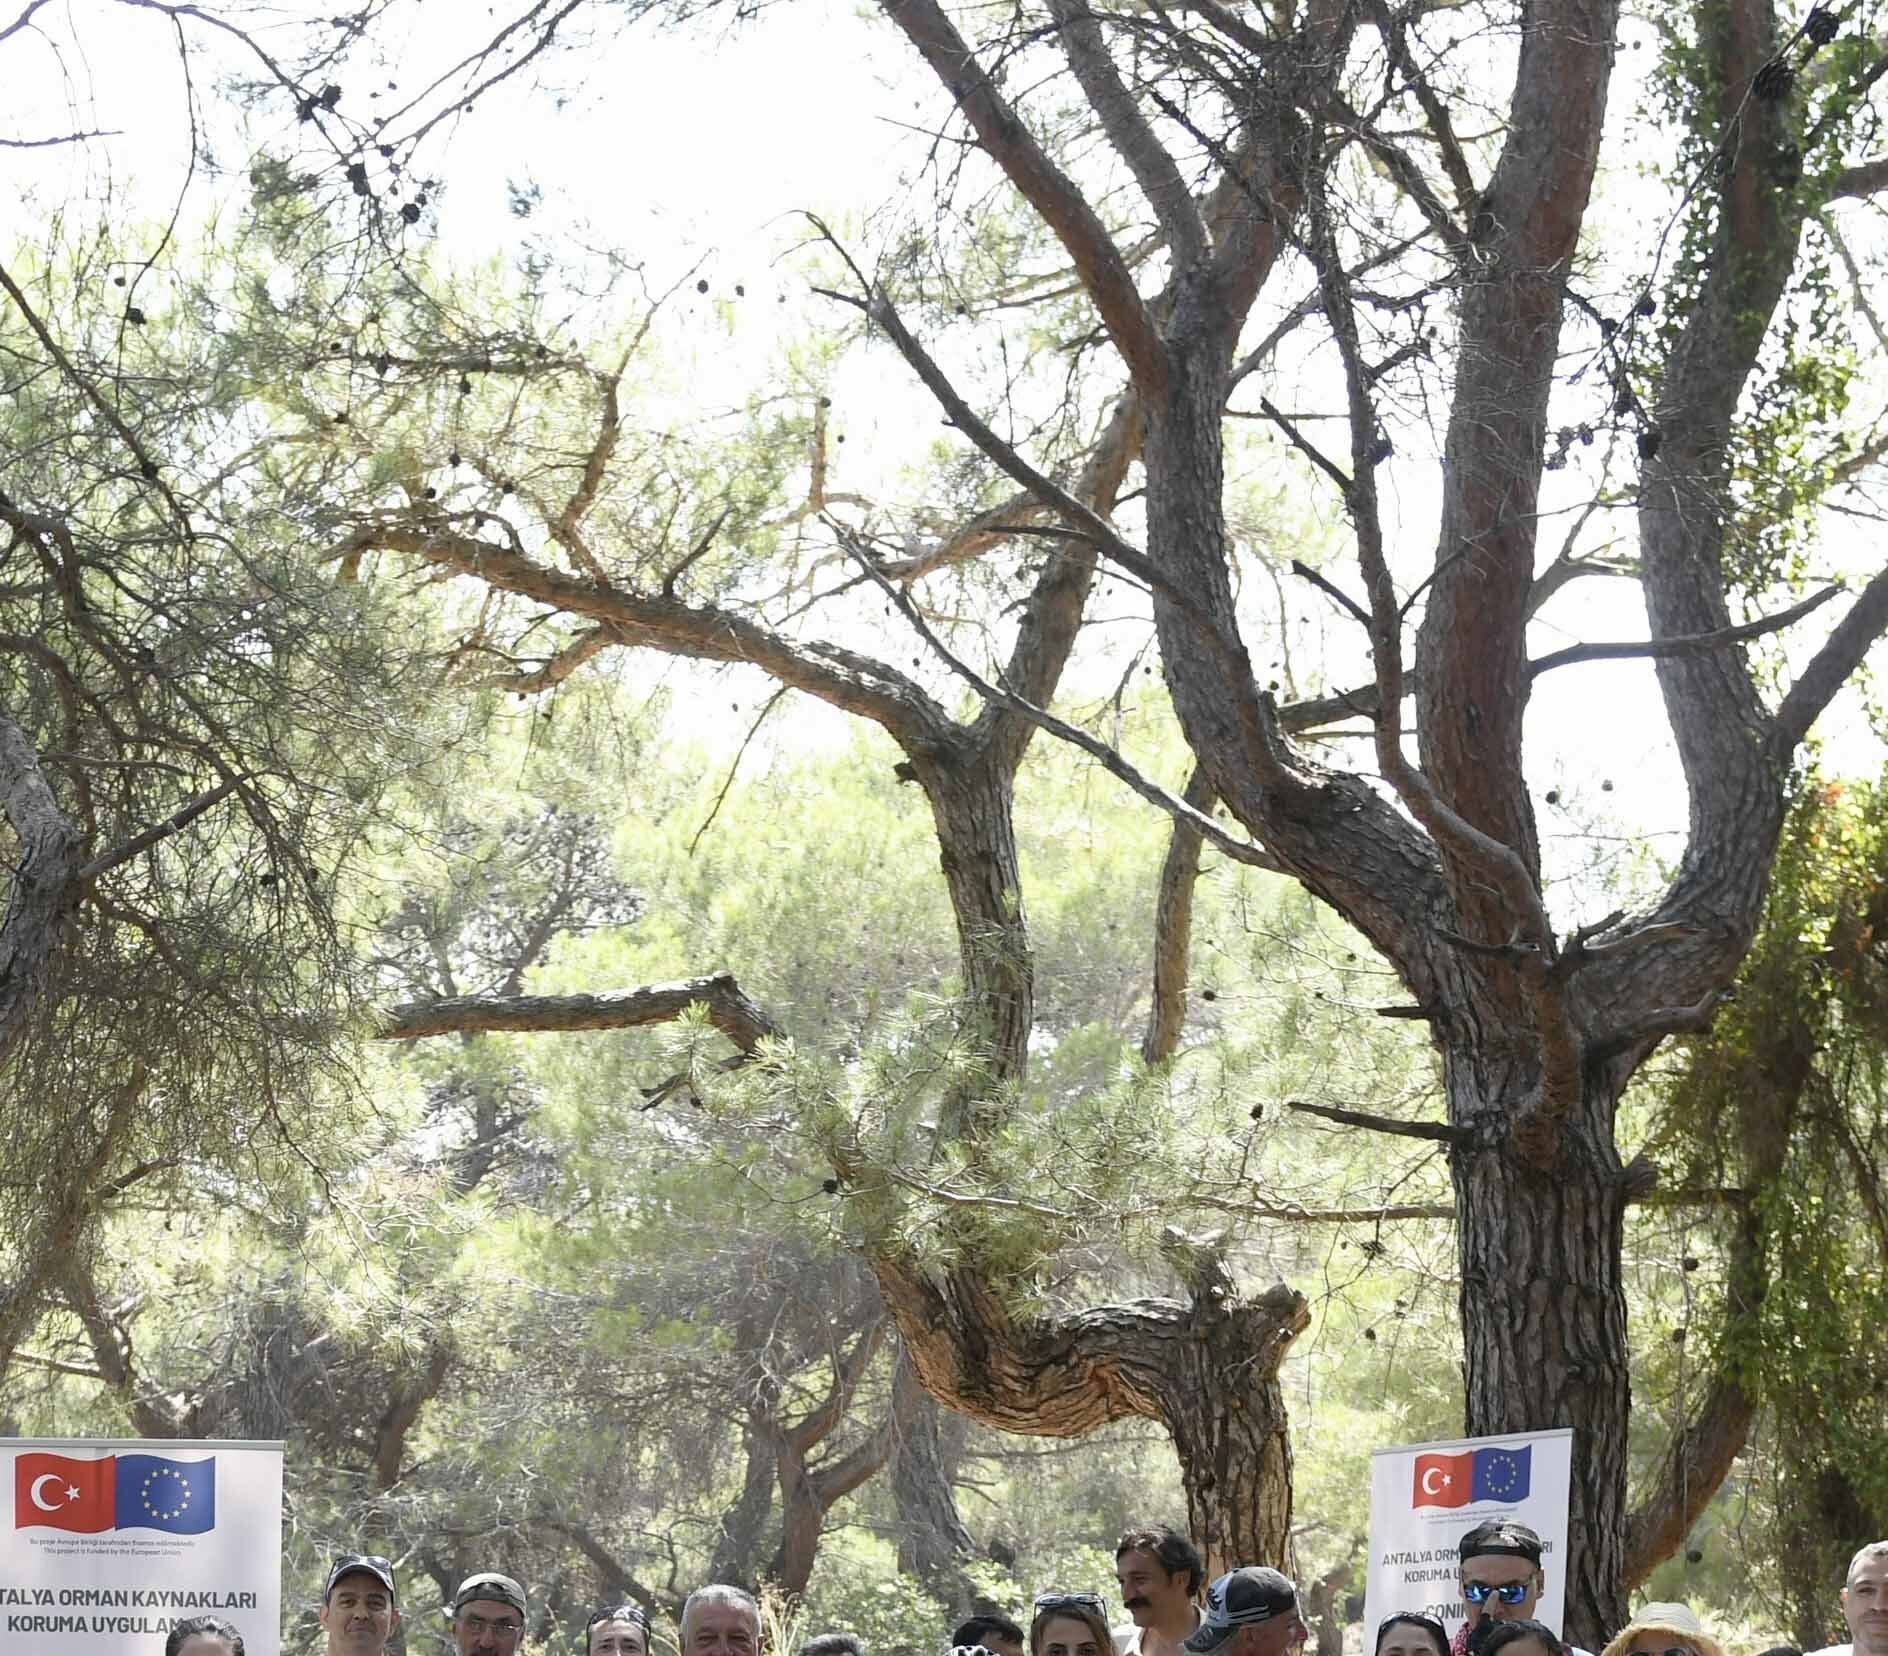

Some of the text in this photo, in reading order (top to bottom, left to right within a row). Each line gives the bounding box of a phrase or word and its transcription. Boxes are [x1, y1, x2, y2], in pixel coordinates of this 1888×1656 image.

[1383, 1549, 1459, 1566] ANTALYA ORM
[1404, 1569, 1450, 1584] KORUMA
[59, 1589, 128, 1608] ORMAN
[132, 1590, 257, 1610] KAYNAKLARI
[8, 1615, 186, 1634] KORUMA UYGULAM
